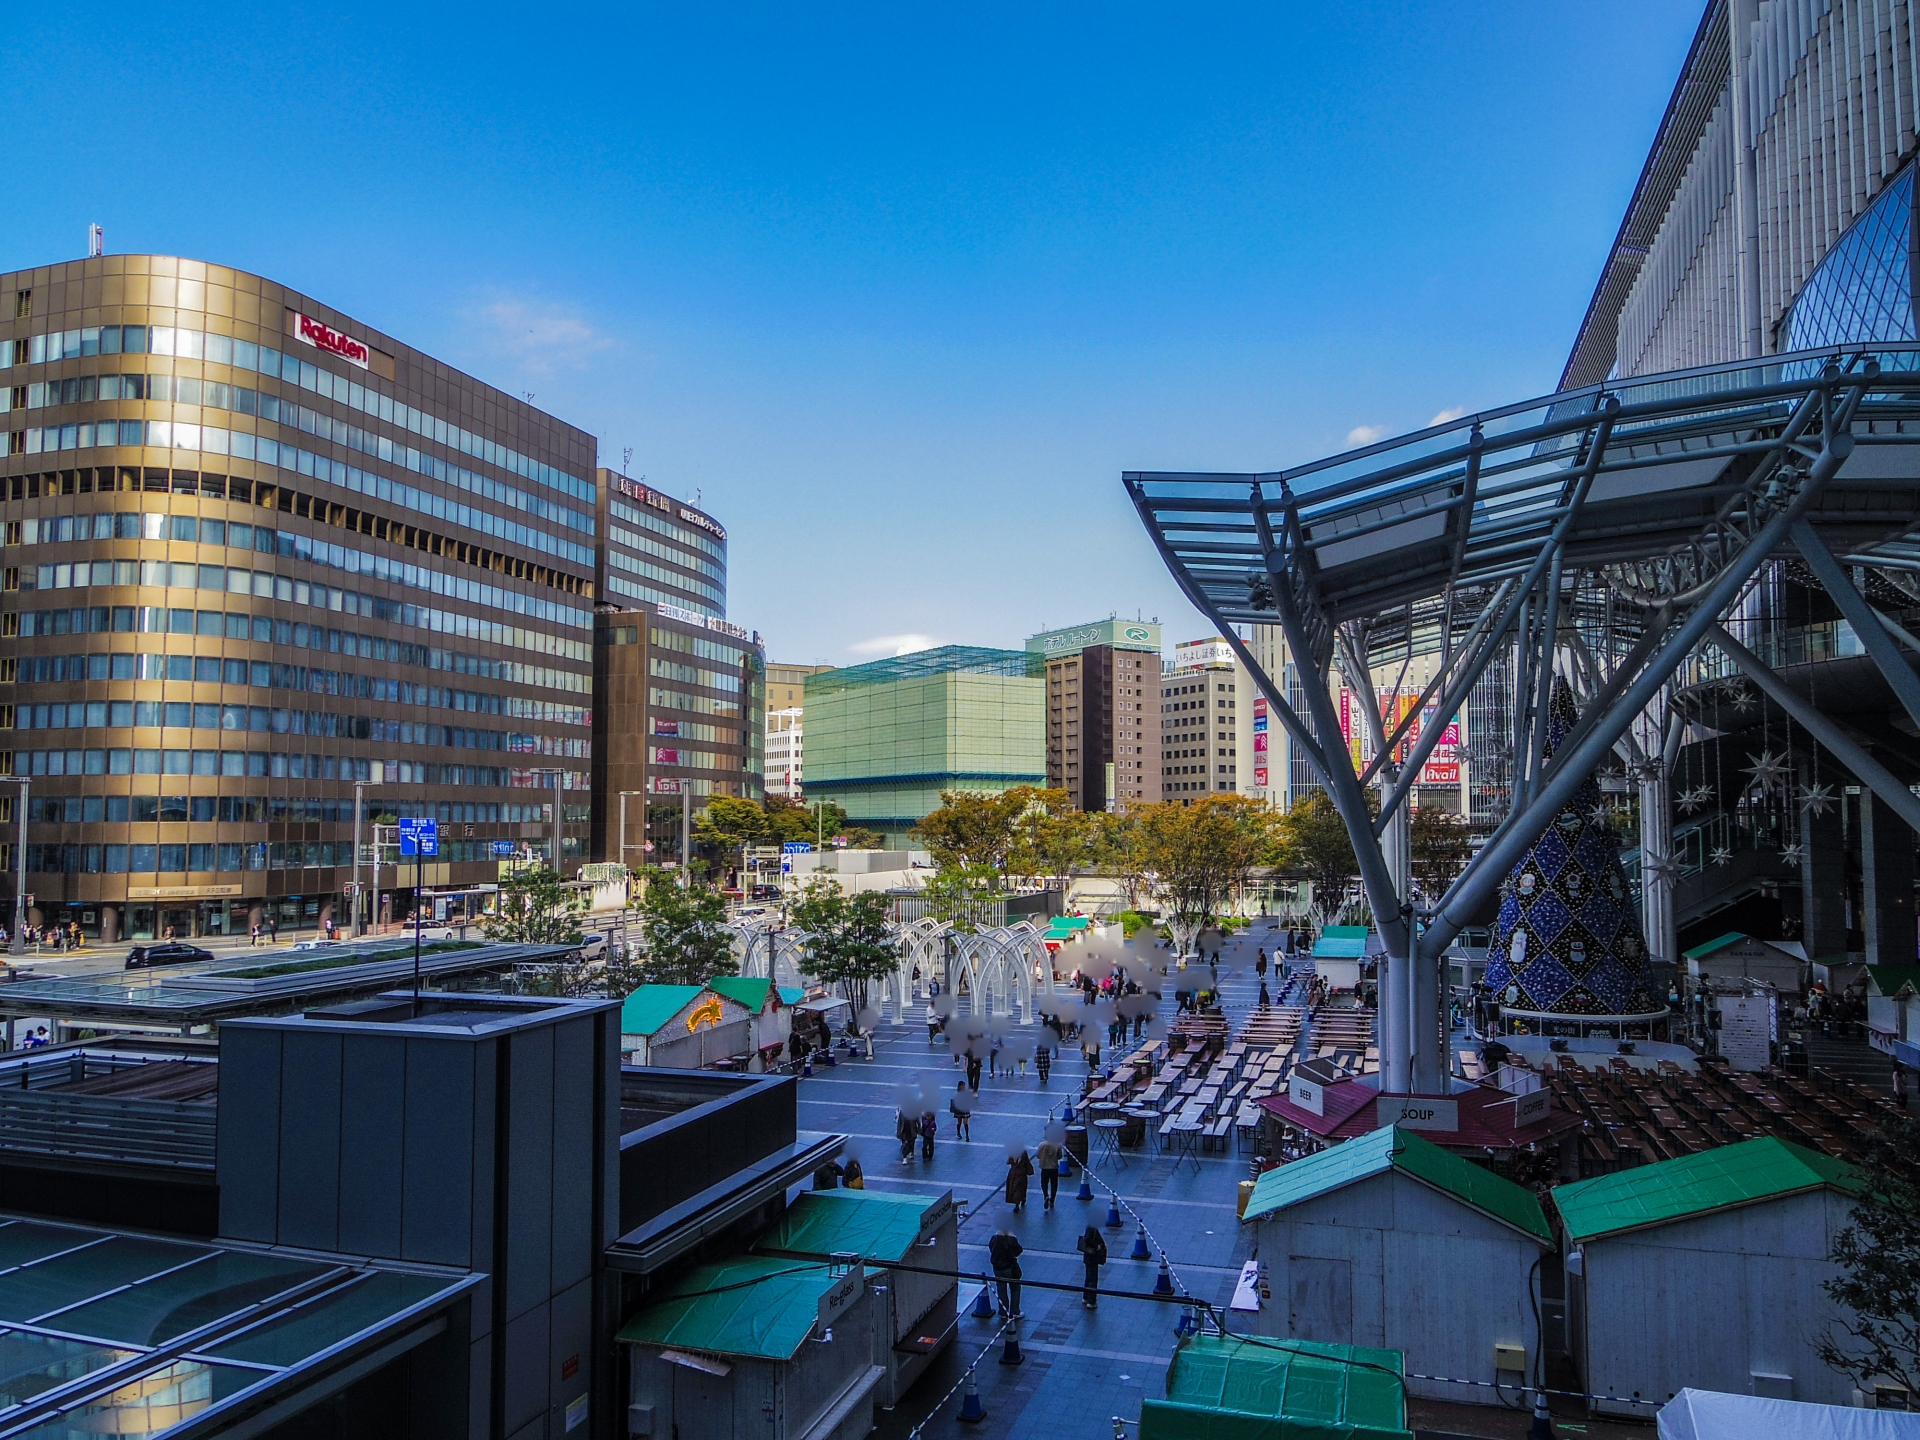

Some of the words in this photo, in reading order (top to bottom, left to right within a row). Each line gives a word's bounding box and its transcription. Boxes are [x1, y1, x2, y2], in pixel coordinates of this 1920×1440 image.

[300, 314, 367, 362] Rakuten
[1217, 647, 1236, 658] いち
[1426, 769, 1457, 780] Avail
[1300, 1088, 1312, 1101] BEER
[1523, 1093, 1545, 1115] COFFEE
[1401, 1108, 1434, 1120] SOUP
[829, 1281, 855, 1311] Re-glass
